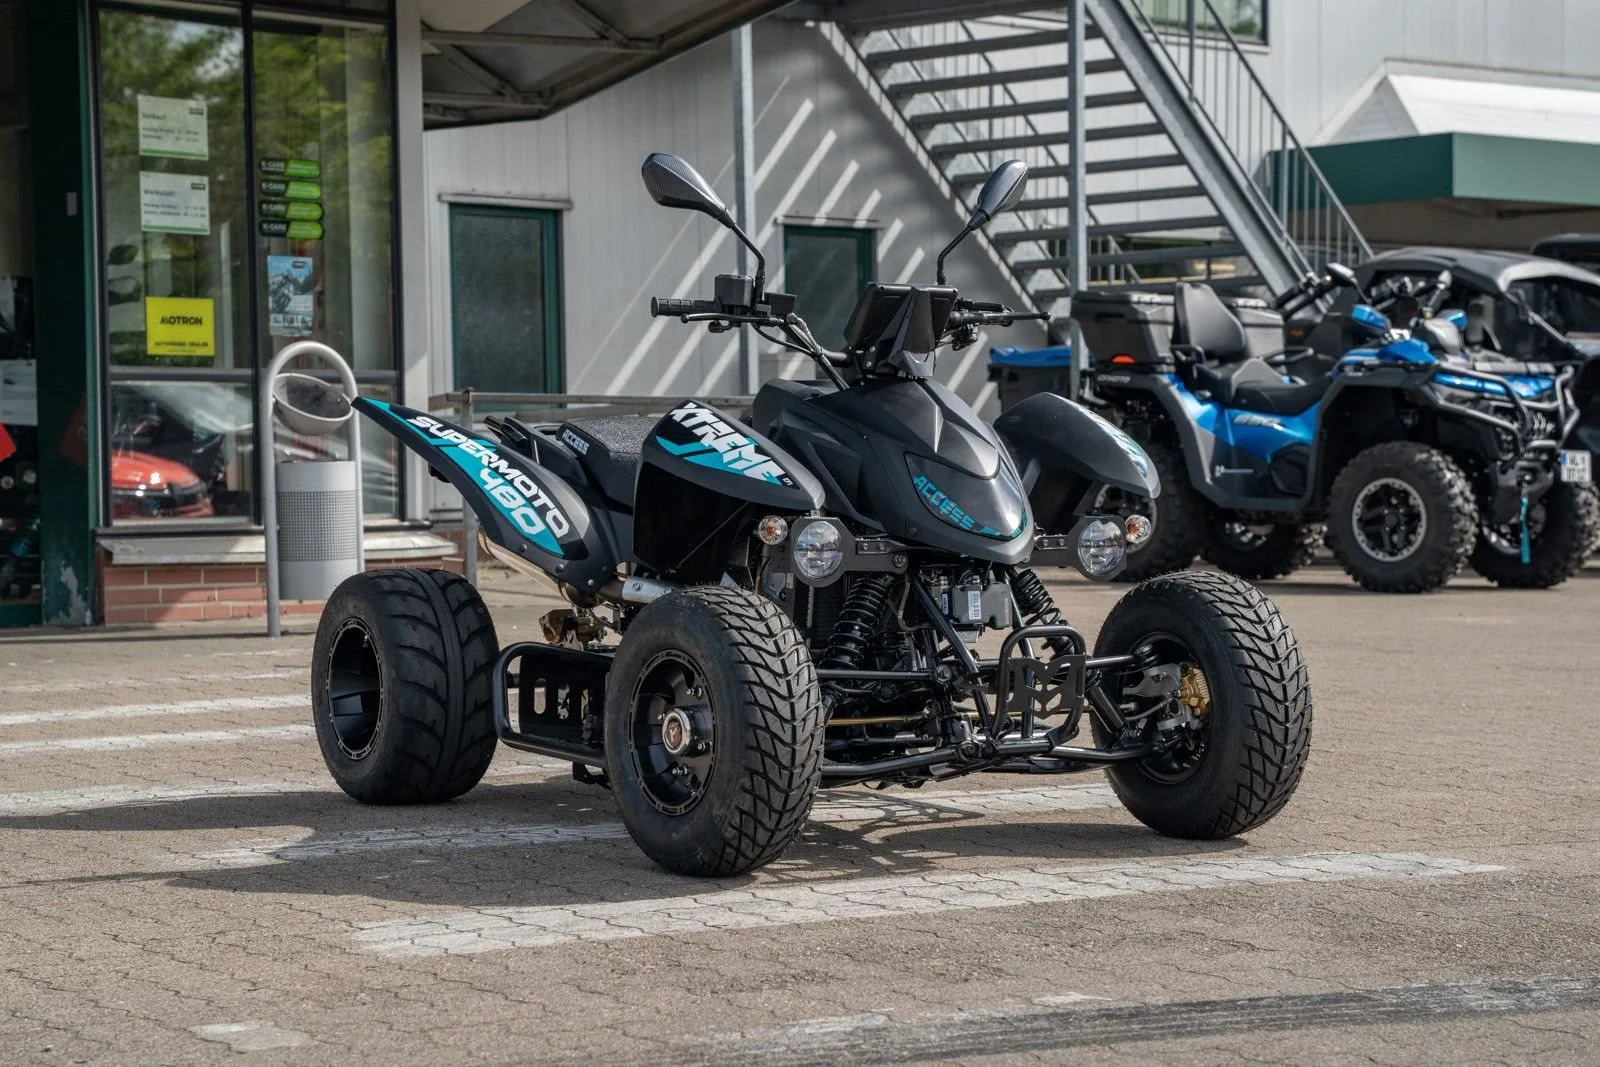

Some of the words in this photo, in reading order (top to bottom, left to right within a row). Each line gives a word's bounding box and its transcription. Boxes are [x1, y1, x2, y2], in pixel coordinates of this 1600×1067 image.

[160, 315, 203, 326] MOTRON
[562, 428, 590, 456] ACCESS
[669, 402, 786, 481] XTREME
[406, 416, 570, 539] SUPERMOTO
[479, 467, 546, 535] 480
[913, 475, 977, 530] ACCESS
